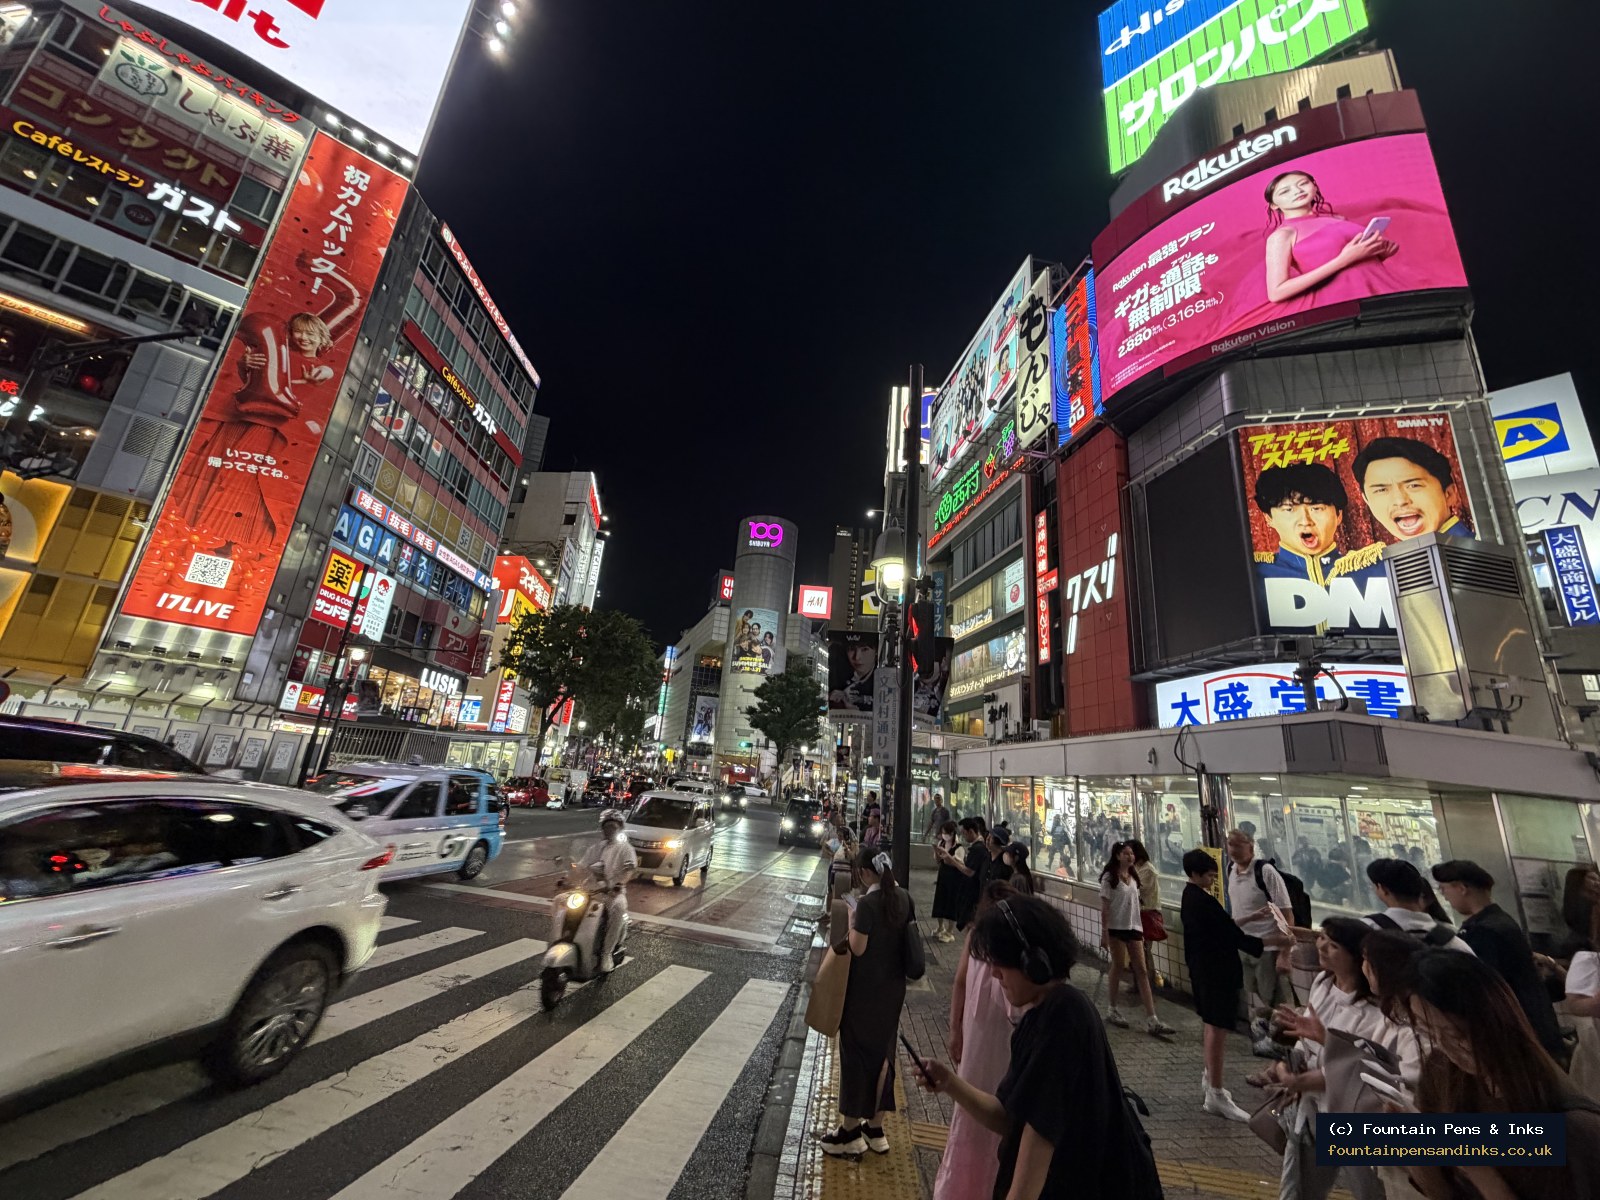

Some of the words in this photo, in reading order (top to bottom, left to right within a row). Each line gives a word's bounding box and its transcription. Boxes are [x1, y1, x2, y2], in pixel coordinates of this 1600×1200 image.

[100, 5, 300, 123] しゃぶしゃぶバイキング
[1119, 0, 1341, 136] サロンパス
[19, 75, 230, 188] コンタクト
[179, 87, 296, 163] しゃぶ葉
[13, 121, 145, 188] Caféレストラン
[1163, 125, 1297, 202] Rakuten
[147, 181, 243, 234] ガスト
[1112, 263, 1147, 292] Rakuten
[1148, 222, 1215, 268] 最強プラン
[451, 240, 509, 334] しゃぶしゃぶバイキング
[1114, 252, 1219, 319] ギガも通話も
[1128, 273, 1202, 332] 無制限
[1211, 332, 1257, 354] Rakuten
[1258, 319, 1296, 338] Vision
[1019, 293, 1050, 433] もんじゃ
[442, 367, 475, 408] Caféレストラン
[473, 403, 497, 436] ガスト
[1397, 420, 1429, 429] DMM
[1429, 417, 1444, 427] TV
[226, 448, 276, 465] いつでも
[1248, 426, 1338, 455] アップデート
[1262, 438, 1350, 471] ストライキ
[208, 457, 289, 480] 帰ってきてね。
[333, 512, 391, 563] AGA
[360, 493, 383, 517] 薄毛
[388, 512, 411, 536] 抜毛
[414, 531, 435, 552] 発毛
[749, 522, 784, 548] 109
[749, 540, 771, 548] SHIBUYA
[319, 588, 336, 601] DRUG
[327, 558, 352, 590] 薬
[477, 574, 492, 591] 4F
[1066, 532, 1118, 655] クスリ
[1551, 533, 1596, 622] 大盛堂商事ビル
[156, 593, 235, 619] 17LIVE
[314, 598, 363, 626] サンドラグ
[807, 596, 824, 607] H&M
[445, 633, 469, 656] アコム
[420, 668, 460, 695] LUSH
[878, 675, 889, 749] 文化村通り
